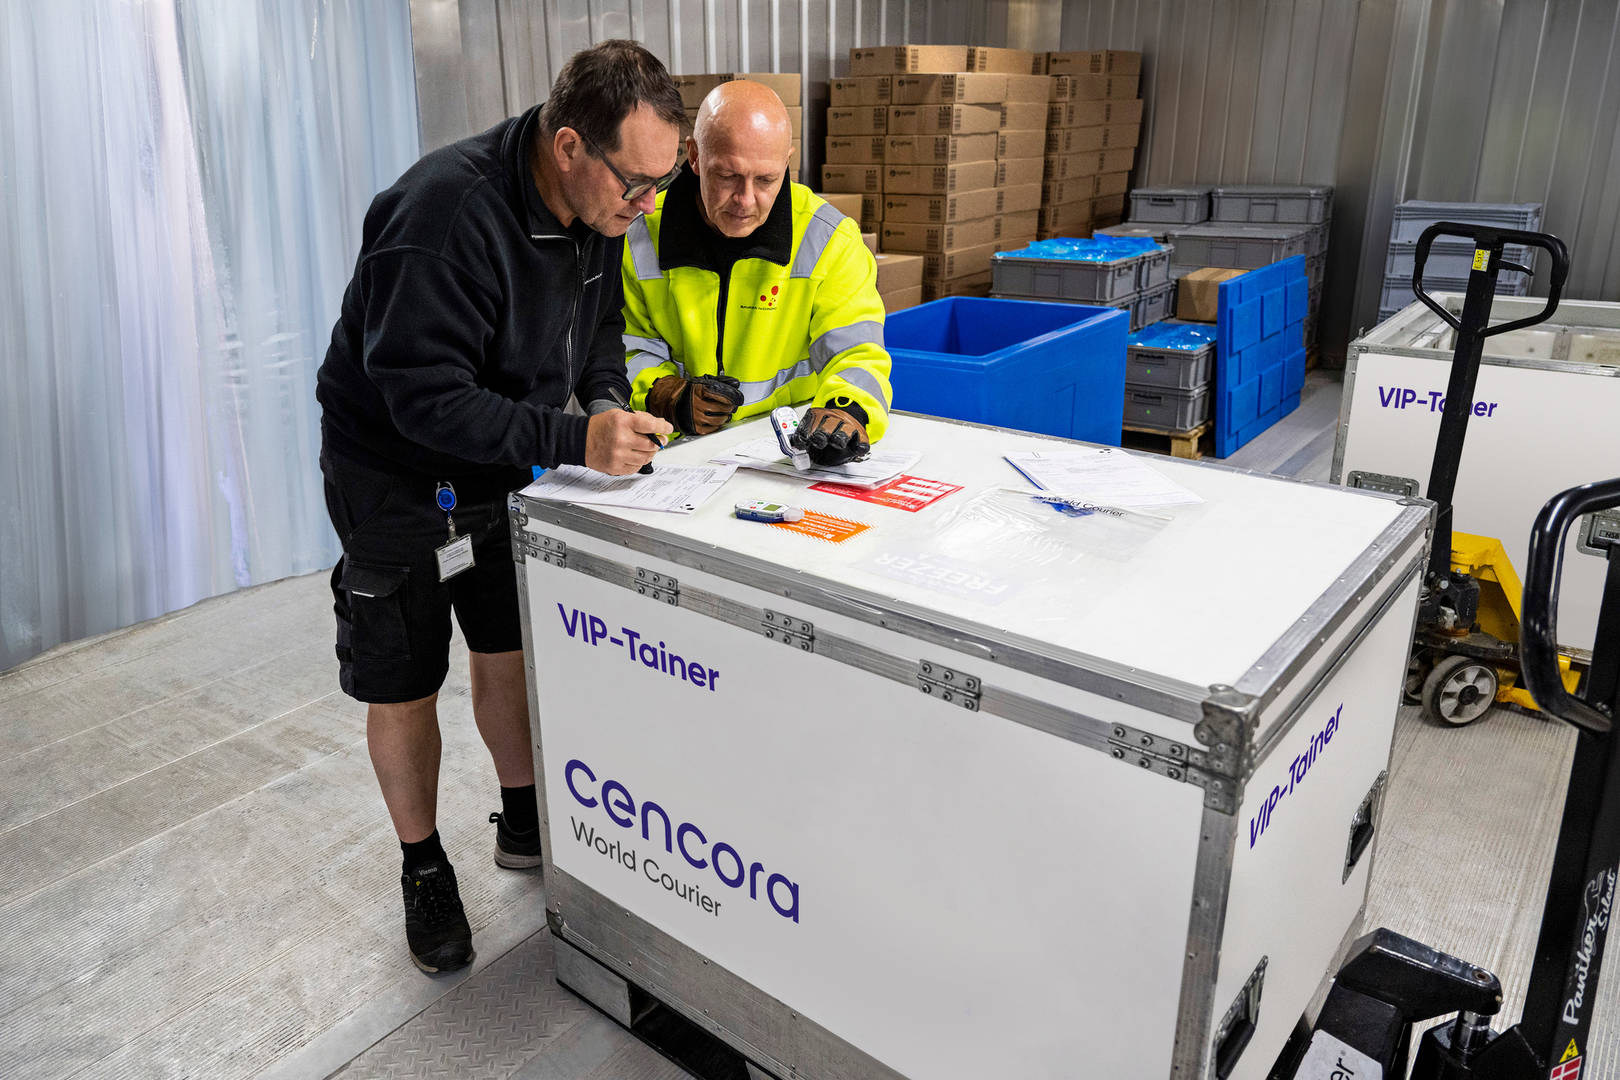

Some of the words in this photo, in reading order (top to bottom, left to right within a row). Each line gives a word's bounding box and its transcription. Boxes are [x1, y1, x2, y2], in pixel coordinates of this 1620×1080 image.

[1378, 386, 1498, 418] VIP-Ter
[1083, 502, 1125, 518] Courier
[873, 552, 1009, 595] FREEZER
[557, 602, 721, 692] VIP-Tainer
[1249, 702, 1344, 850] VIP-Tainer
[564, 758, 801, 924] cencora
[570, 815, 637, 873] World
[643, 857, 722, 918] Courier
[1597, 867, 1617, 932] Silent
